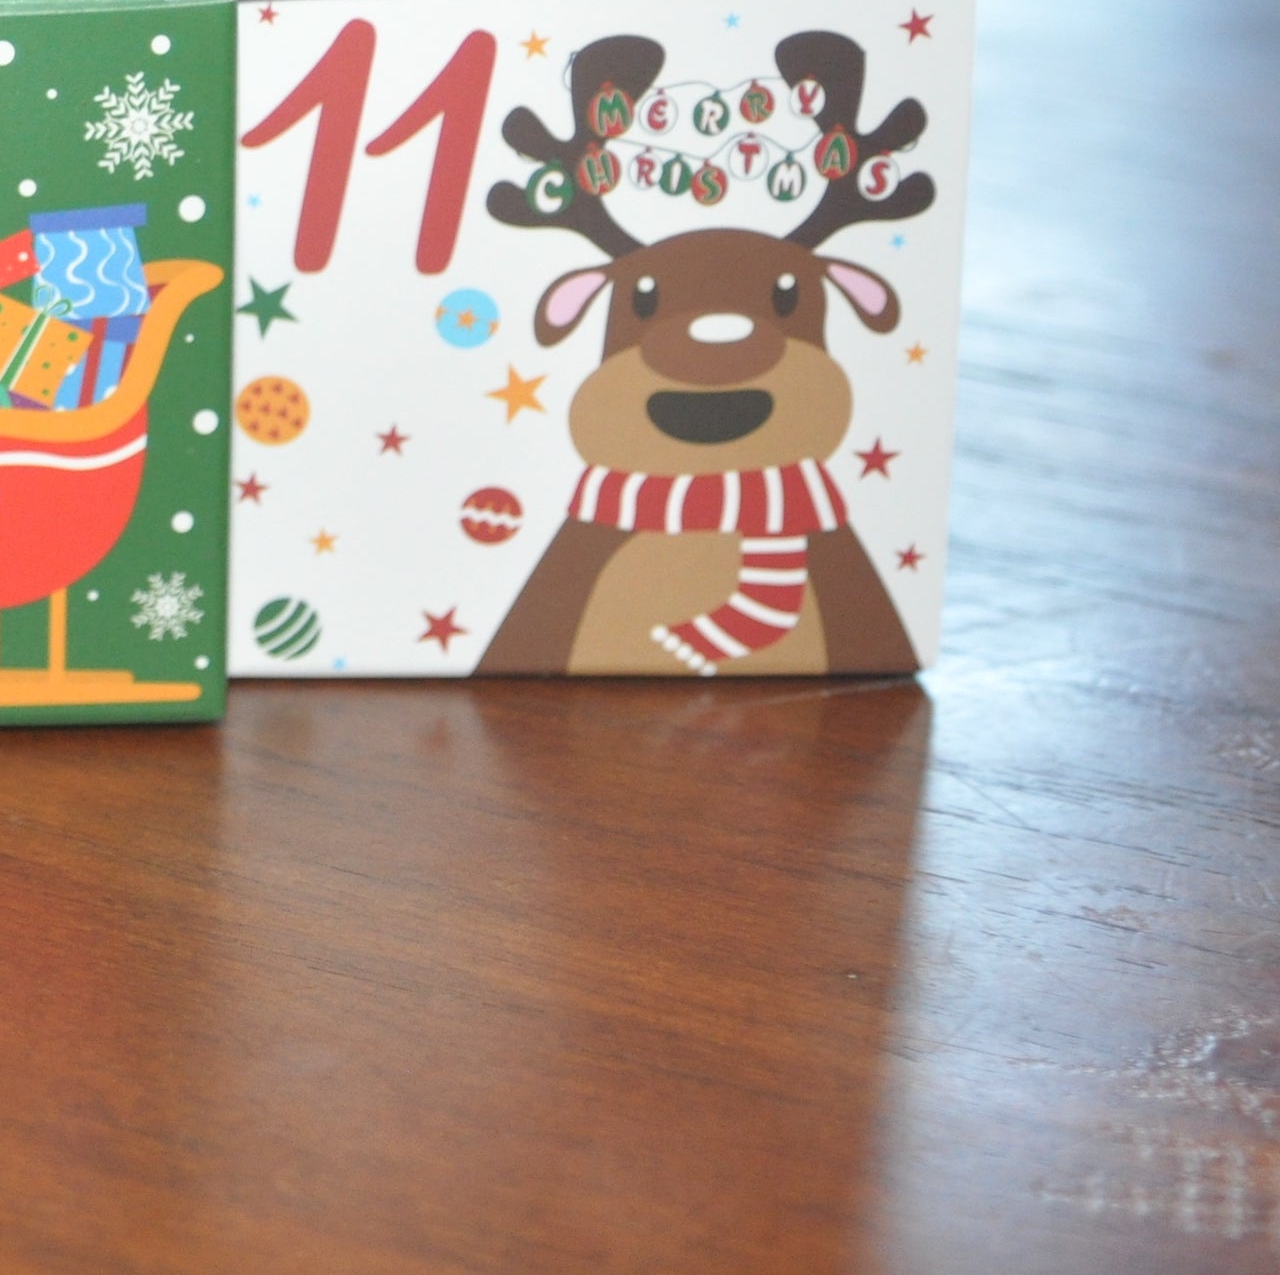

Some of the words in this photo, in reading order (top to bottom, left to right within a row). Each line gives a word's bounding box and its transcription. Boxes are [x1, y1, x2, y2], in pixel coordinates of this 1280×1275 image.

[240, 18, 497, 276] 11
[593, 79, 823, 137] MERRY
[534, 127, 893, 215] CHRISTMAS
